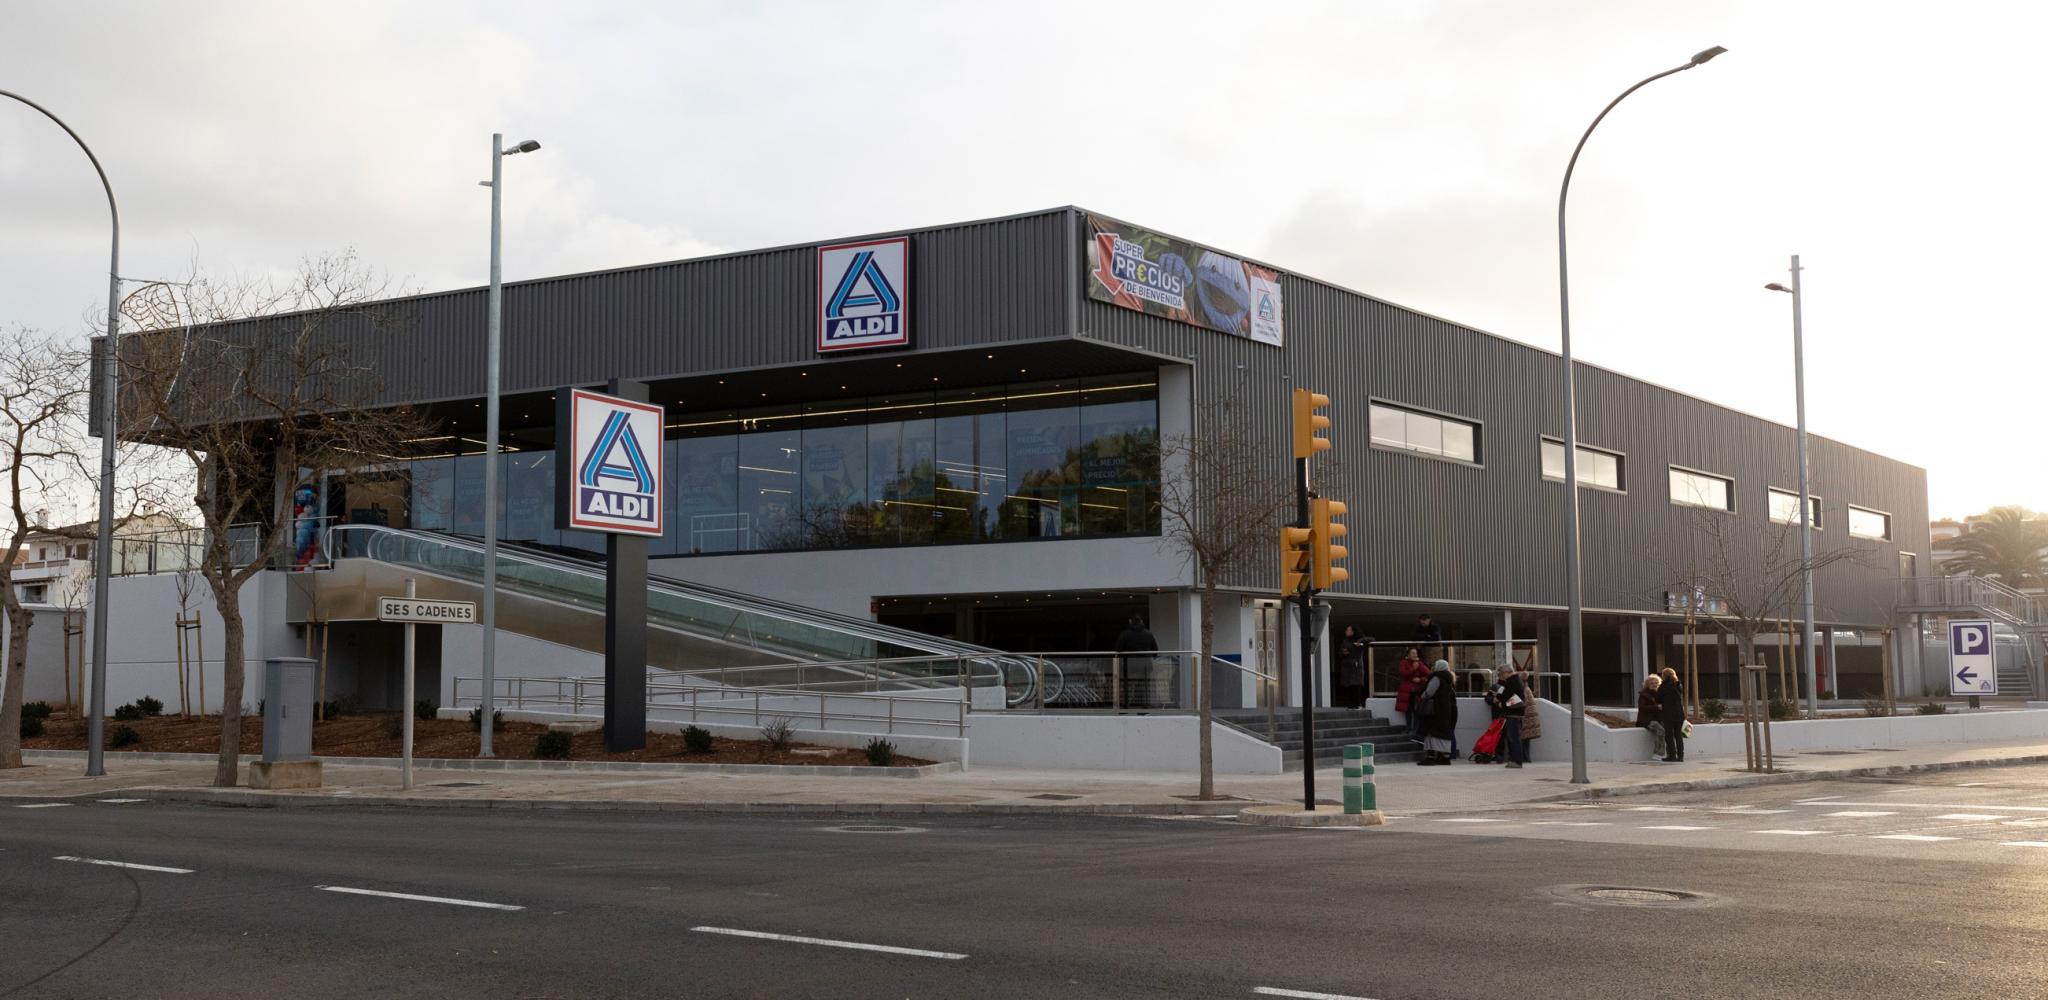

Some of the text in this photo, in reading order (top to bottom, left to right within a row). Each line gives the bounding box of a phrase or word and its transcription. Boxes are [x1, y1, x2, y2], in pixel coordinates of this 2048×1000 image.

[1114, 240, 1143, 258] SUPER
[1126, 281, 1183, 307] DE BIENVENIDA
[833, 316, 893, 338] ALDI
[587, 491, 648, 519] ALDI
[385, 603, 472, 619] SES CADENES
[1960, 627, 1984, 653] P
